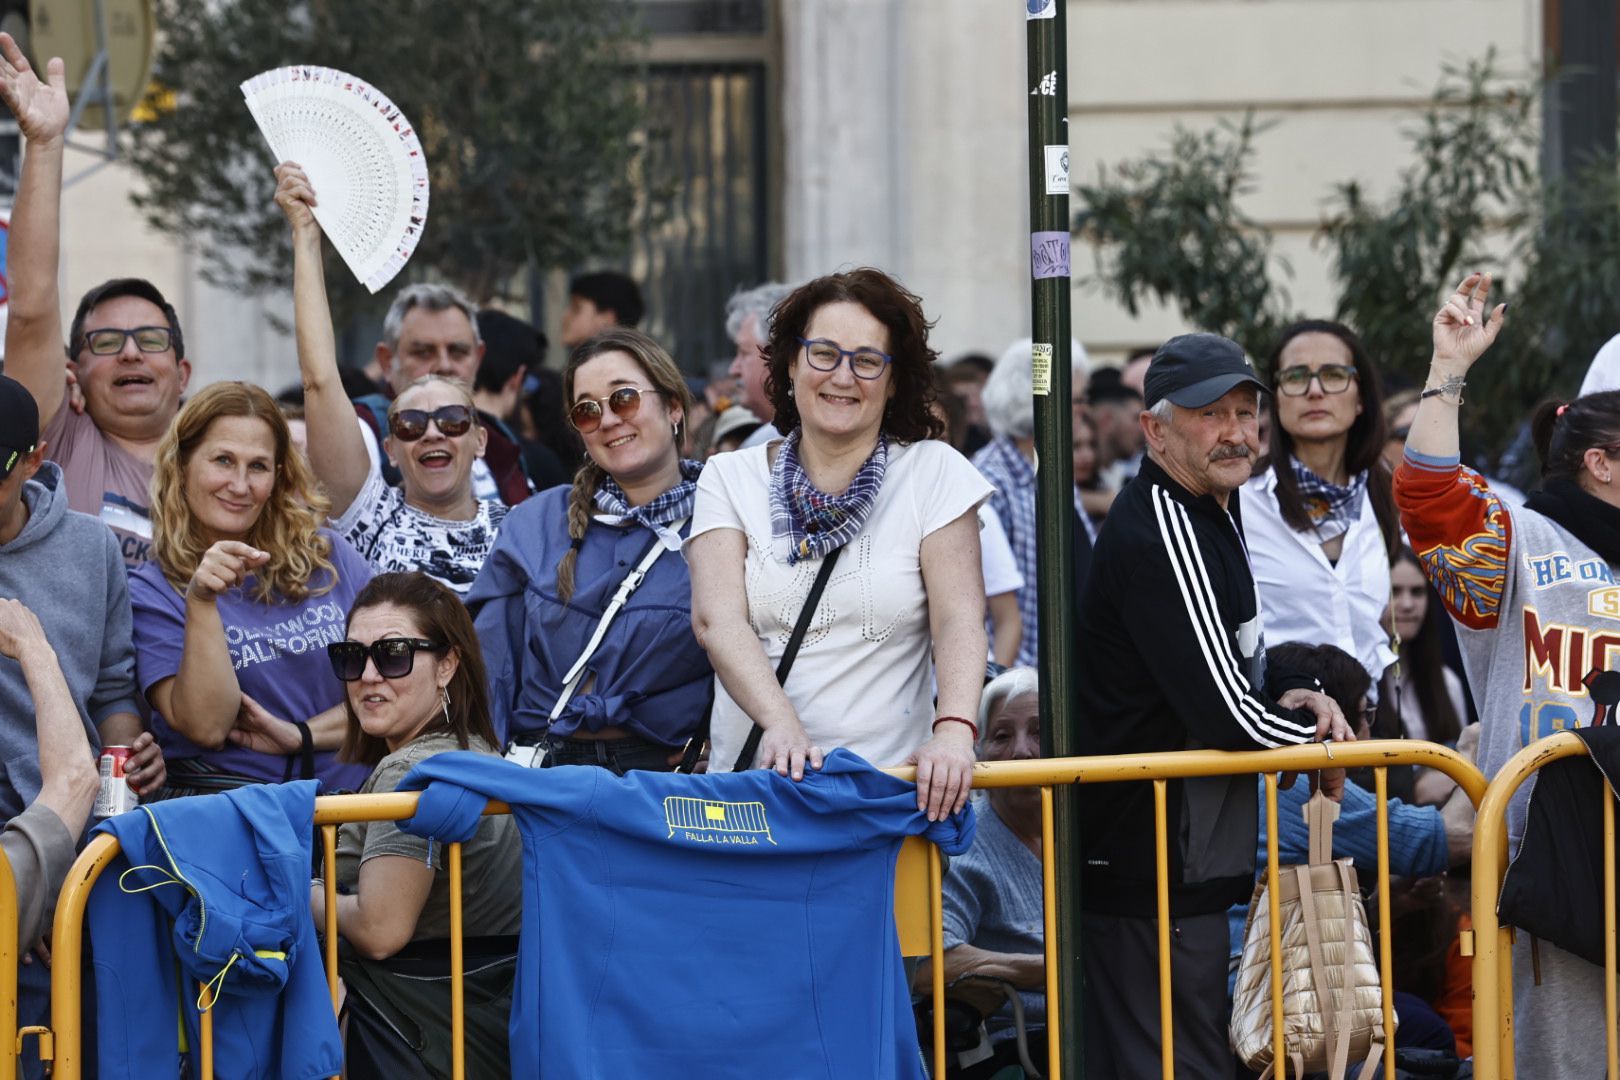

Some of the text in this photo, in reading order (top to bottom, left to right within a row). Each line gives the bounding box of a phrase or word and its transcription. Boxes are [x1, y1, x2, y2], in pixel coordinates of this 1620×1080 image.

[1523, 555, 1574, 589] HE
[685, 831, 759, 846] FALLA LA VALLA
